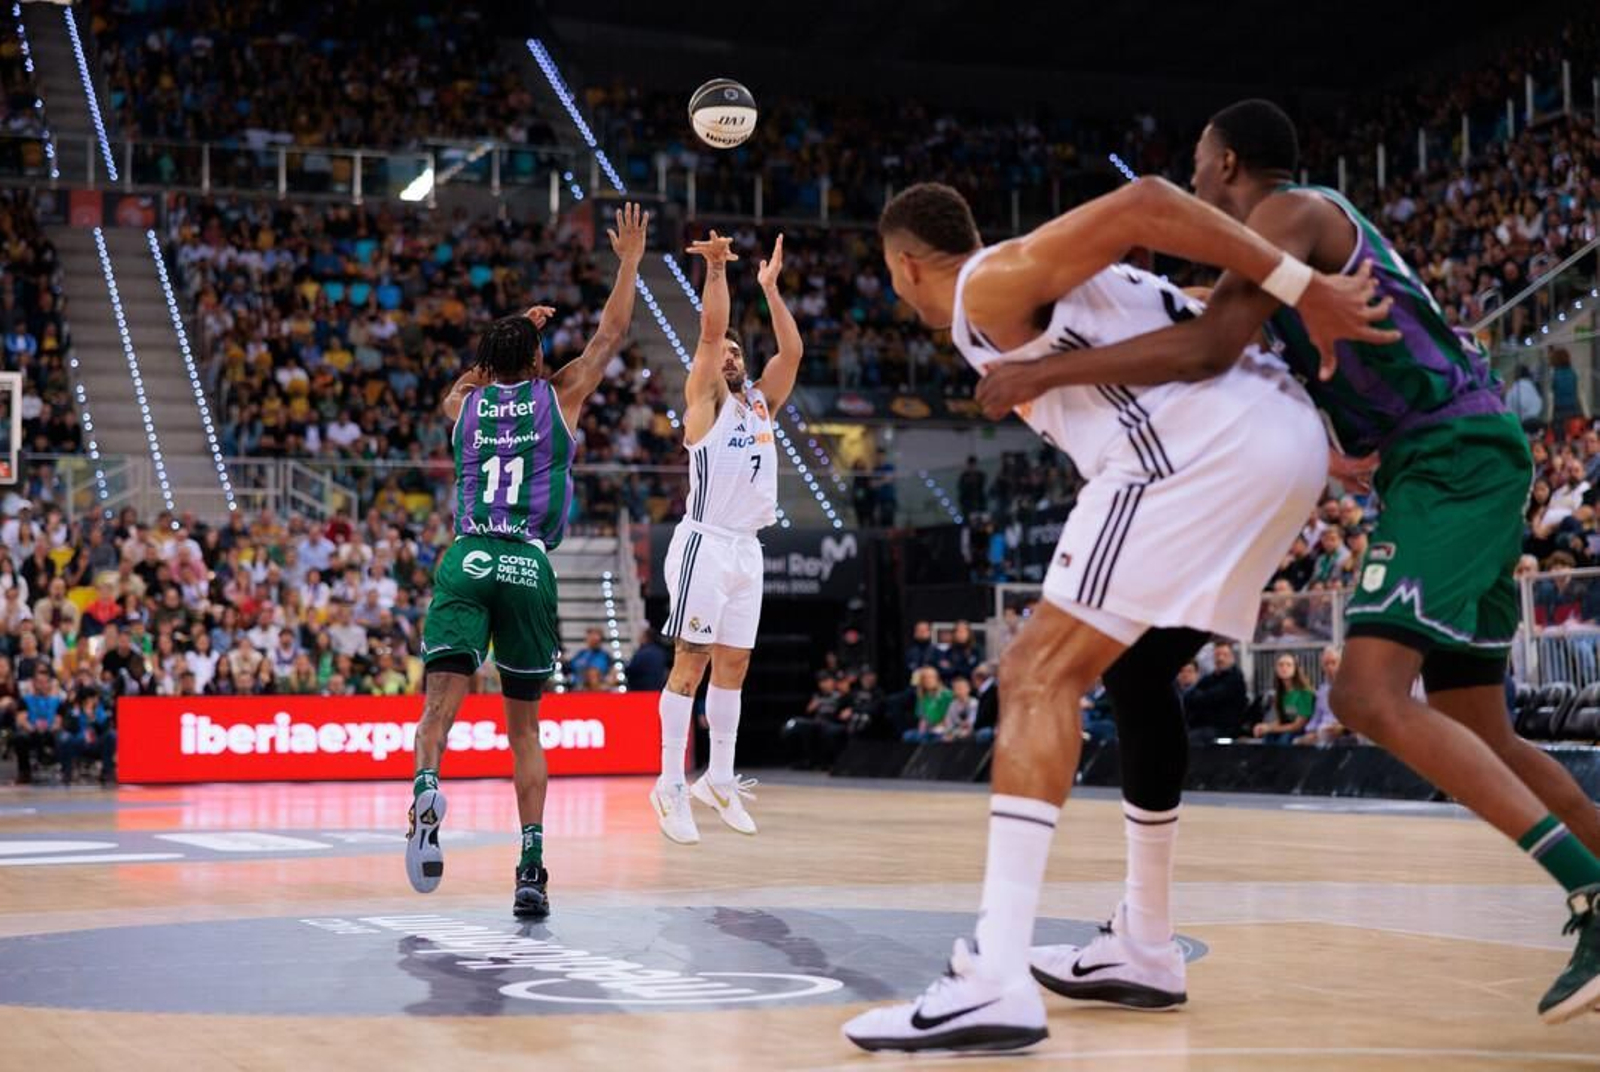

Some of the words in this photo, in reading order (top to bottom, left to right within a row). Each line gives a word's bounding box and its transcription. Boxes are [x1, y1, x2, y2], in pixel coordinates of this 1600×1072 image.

[476, 398, 537, 418] Carter
[481, 455, 525, 505] 11
[750, 454, 762, 484] 7
[498, 554, 540, 570] COSTA
[498, 563, 520, 575] DEL
[520, 567, 540, 580] SOL
[496, 572, 538, 589] MÁLAGA
[180, 711, 606, 761] iberiaexprss.om
[358, 914, 756, 999] mediolanum
